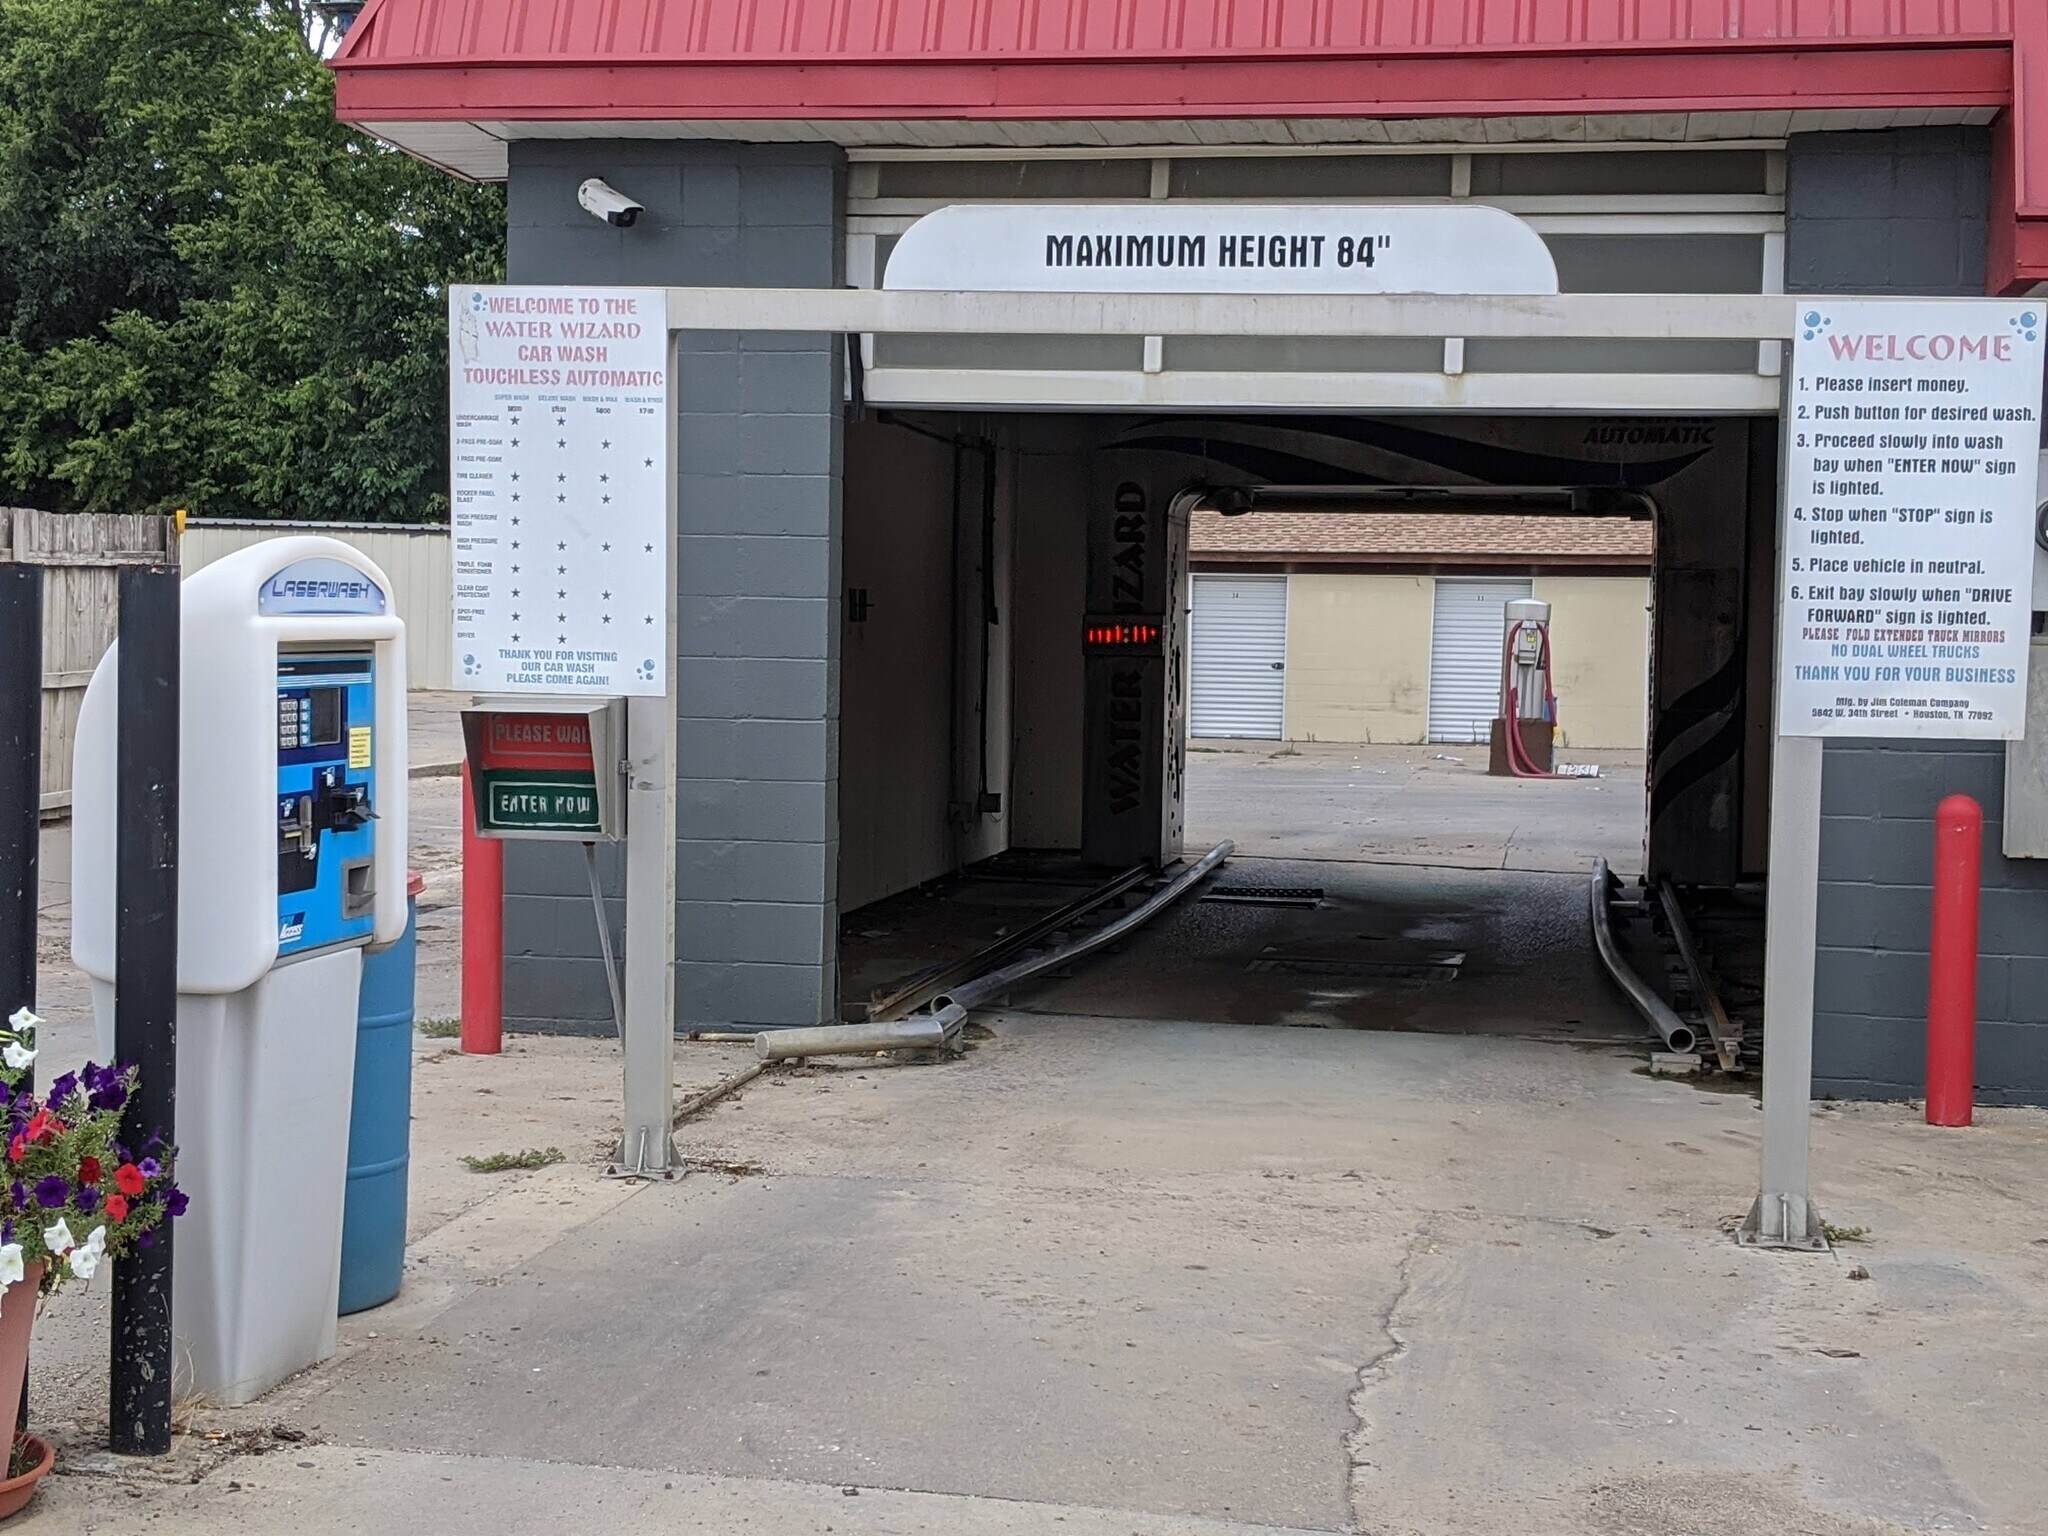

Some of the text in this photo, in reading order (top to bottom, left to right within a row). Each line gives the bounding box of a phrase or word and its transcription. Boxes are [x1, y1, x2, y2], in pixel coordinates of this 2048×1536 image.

[1046, 234, 1391, 268] MAXIMUM HEIGHT 84"
[488, 297, 637, 315] WELCOME TO THE
[485, 321, 641, 339] WATER WIZARD
[518, 345, 607, 362] CAR WASH
[1828, 334, 2012, 361] WELCOME
[464, 368, 663, 386] TOUCHLESS AUTOMATIC
[1799, 377, 1969, 393] 1. Please insert money.
[1798, 406, 2035, 422] 2. Push button for desired wash.
[1584, 427, 1716, 444] AUTOMATIC
[1797, 434, 2003, 450] 3. Proceed slowly into wash
[1814, 458, 2016, 475] bay when "ENTER NOW" sign
[1813, 481, 1884, 496] is lighted.
[1794, 507, 1993, 524] 4. Stop when "STOP" sign is
[1811, 530, 1864, 545] lighted.
[1792, 558, 1985, 574] 5. Place vehicle in neutral.
[272, 580, 370, 598] LASERWASH
[1791, 586, 2012, 603] 6. Exit bay slowly when "DRIVE
[1808, 609, 1990, 625] FORWARD" sign is lighted.
[1803, 628, 2005, 642] PLEASE FOLD EXTENDED TRUCK MIRRORS
[499, 649, 617, 661] THANK YOU FOR VISITING
[1832, 645, 1979, 659] NO DUAL WHEEL TRUCKS
[522, 662, 594, 672] OUR CAR WASH
[1795, 666, 2015, 683] THANK YOU FOR YOUR BUSINESS
[507, 674, 609, 685] PLEASE COME AGAIN!
[1858, 698, 1868, 707] by
[1871, 698, 1887, 707] Jim
[1890, 699, 1927, 707] Coleman
[1930, 699, 1969, 709] Company
[1812, 709, 1833, 717] 5842
[1848, 710, 1868, 718] 34th
[1871, 709, 1897, 718] Street
[1913, 710, 1950, 720] Houston,
[1968, 711, 1993, 720] 77092
[495, 725, 590, 743] PLEASE WAI
[1110, 669, 1144, 816] WATER
[502, 795, 590, 813] ENTER NOW
